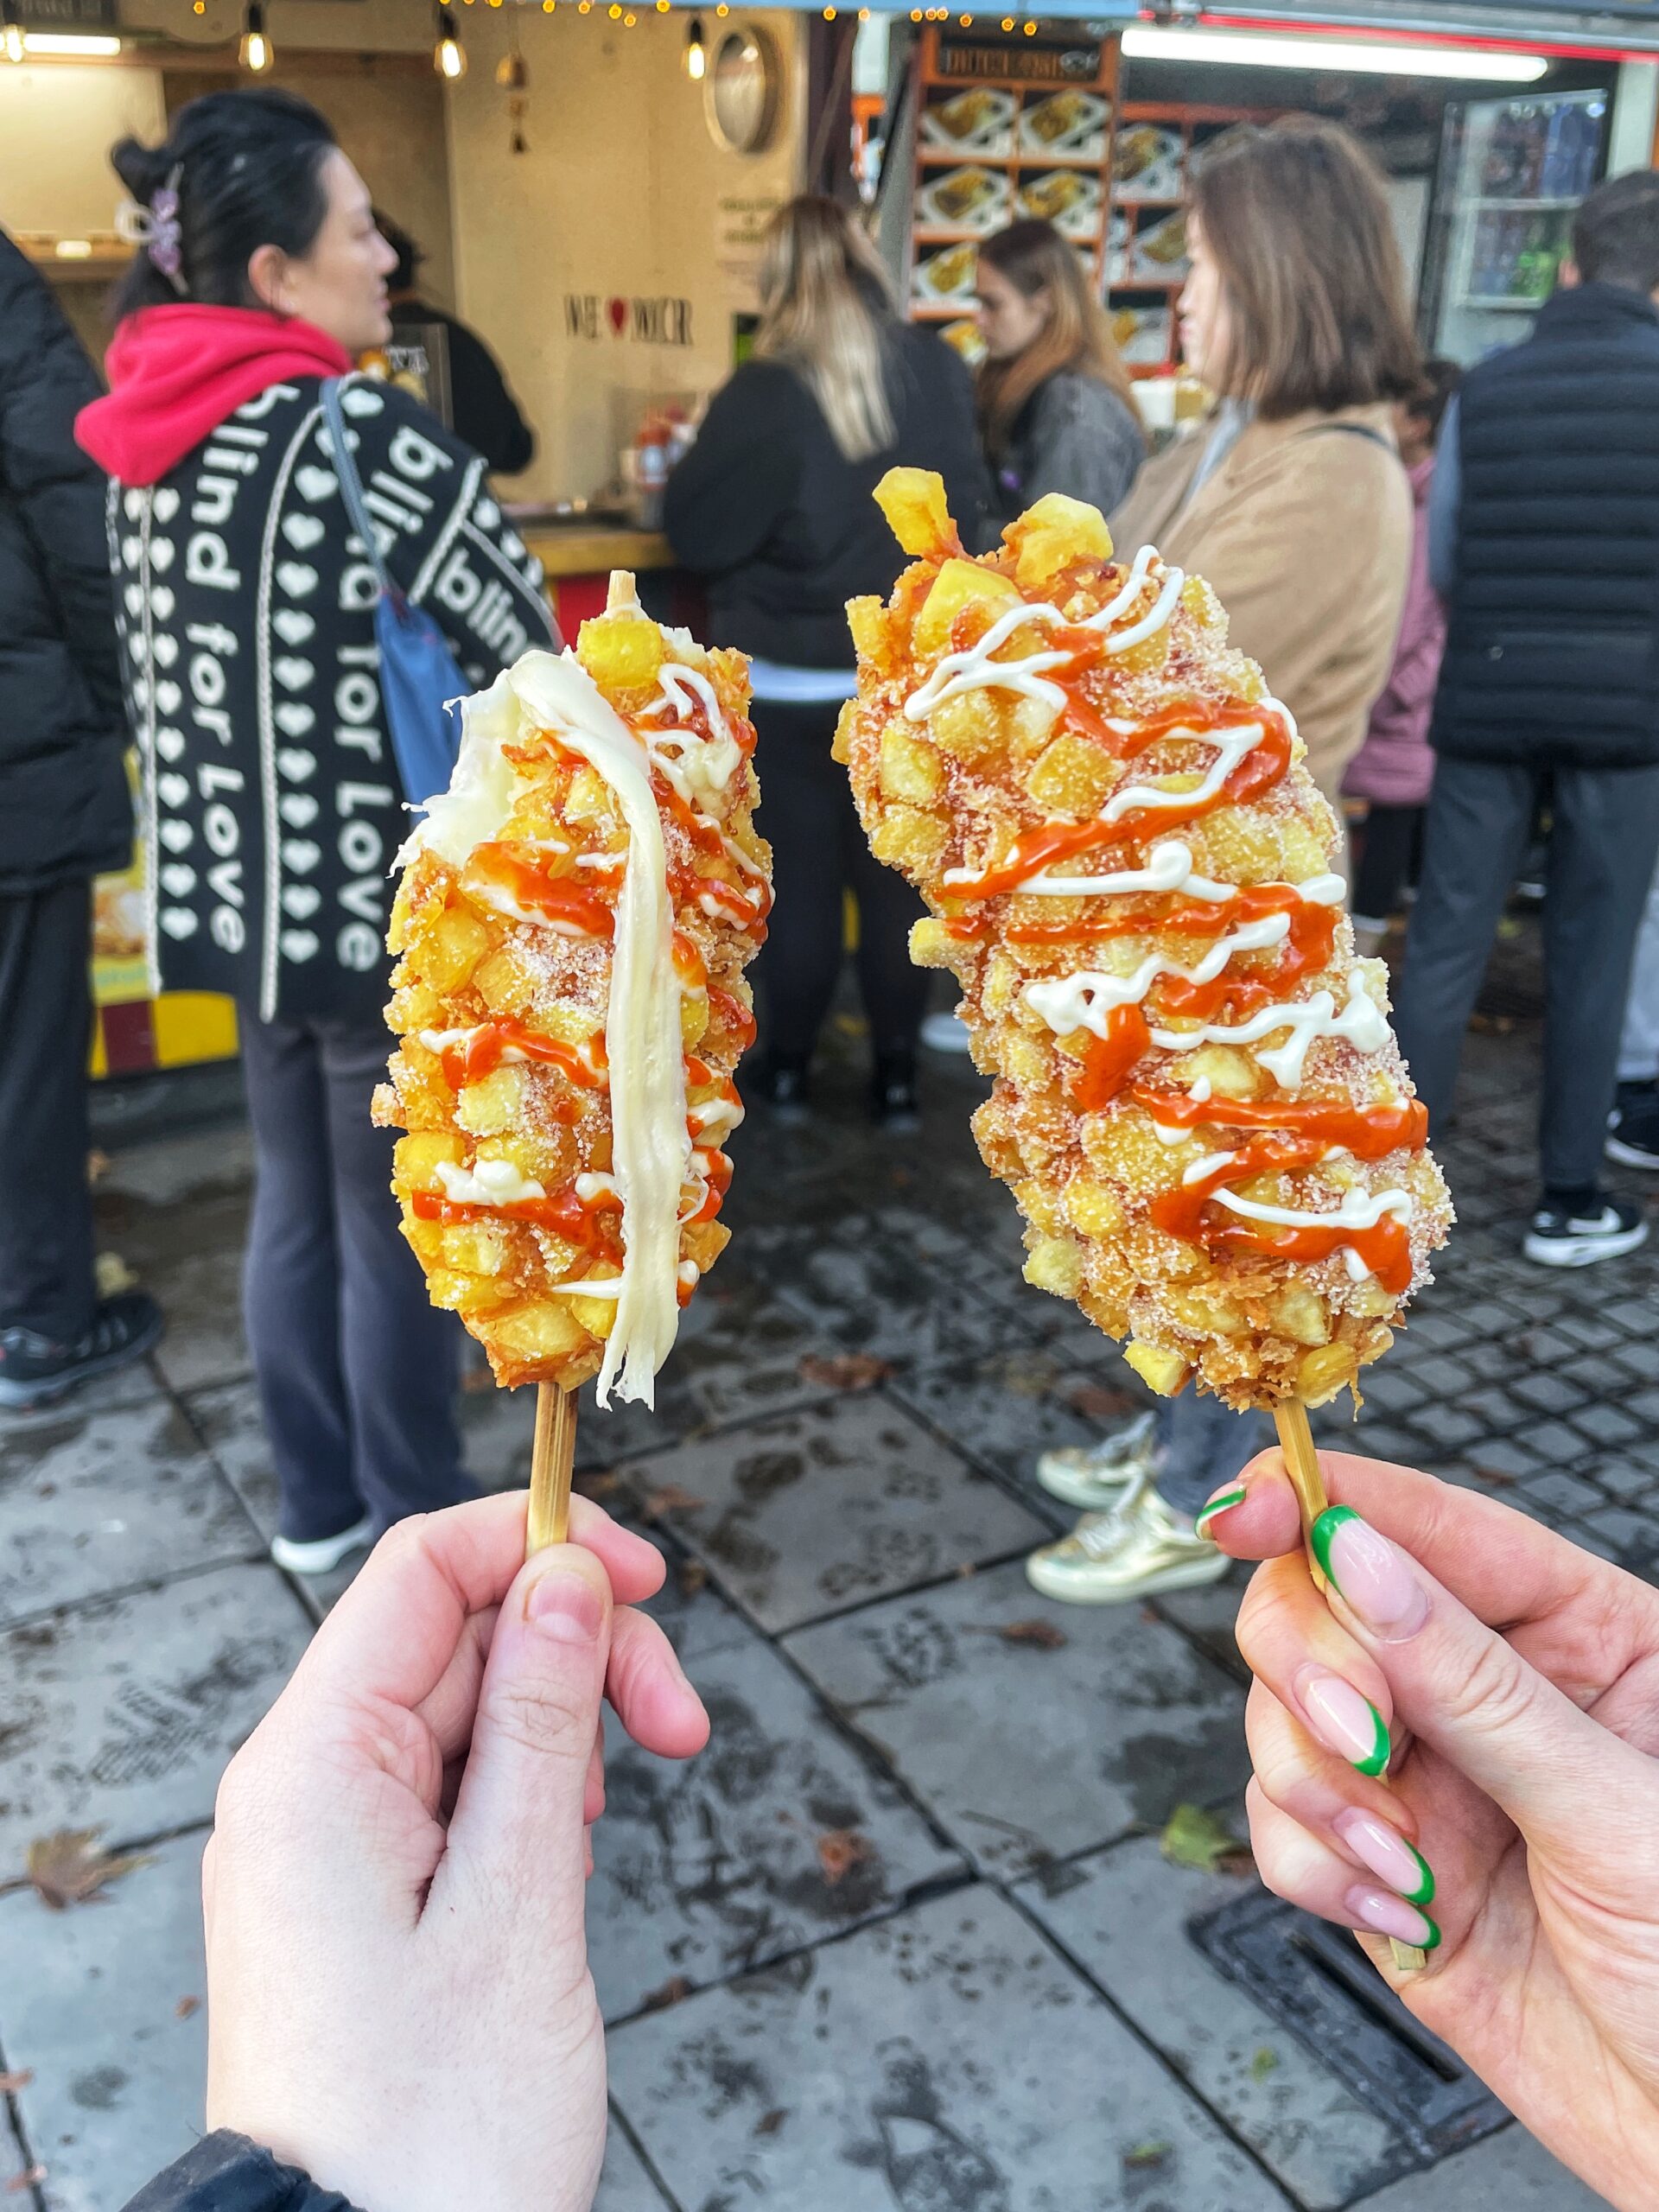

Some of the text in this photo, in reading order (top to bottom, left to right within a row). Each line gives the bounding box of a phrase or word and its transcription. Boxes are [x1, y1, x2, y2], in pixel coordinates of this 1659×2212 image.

[185, 622, 238, 747] for
[435, 547, 532, 669] blin
[196, 762, 245, 955] Love
[335, 780, 394, 972] Love
